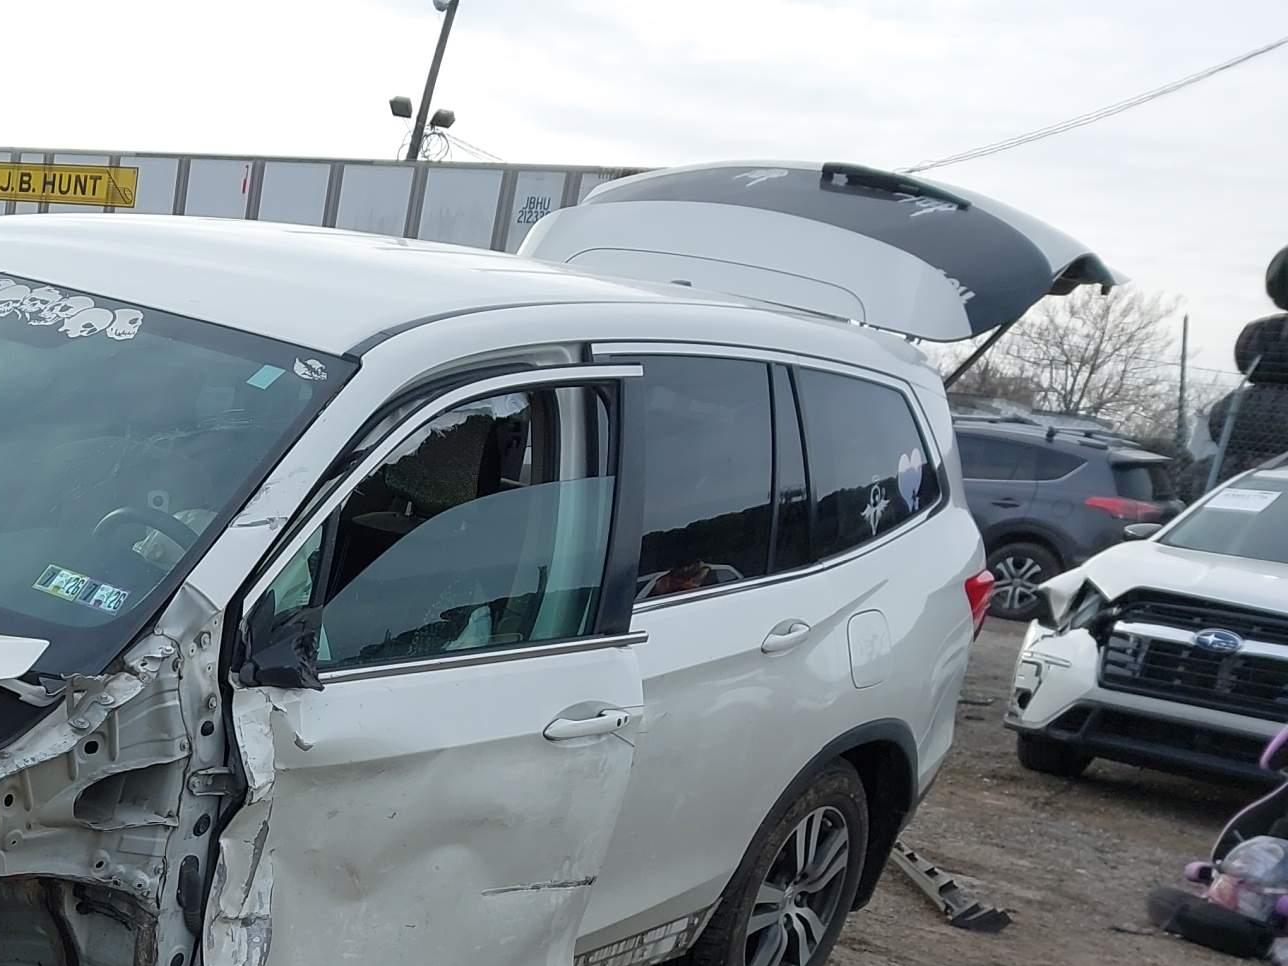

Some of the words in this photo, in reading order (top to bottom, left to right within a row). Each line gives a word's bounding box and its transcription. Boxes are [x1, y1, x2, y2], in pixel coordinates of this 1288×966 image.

[0, 170, 36, 193] J.B.
[42, 172, 103, 197] HUNT
[522, 196, 552, 211] JBHU
